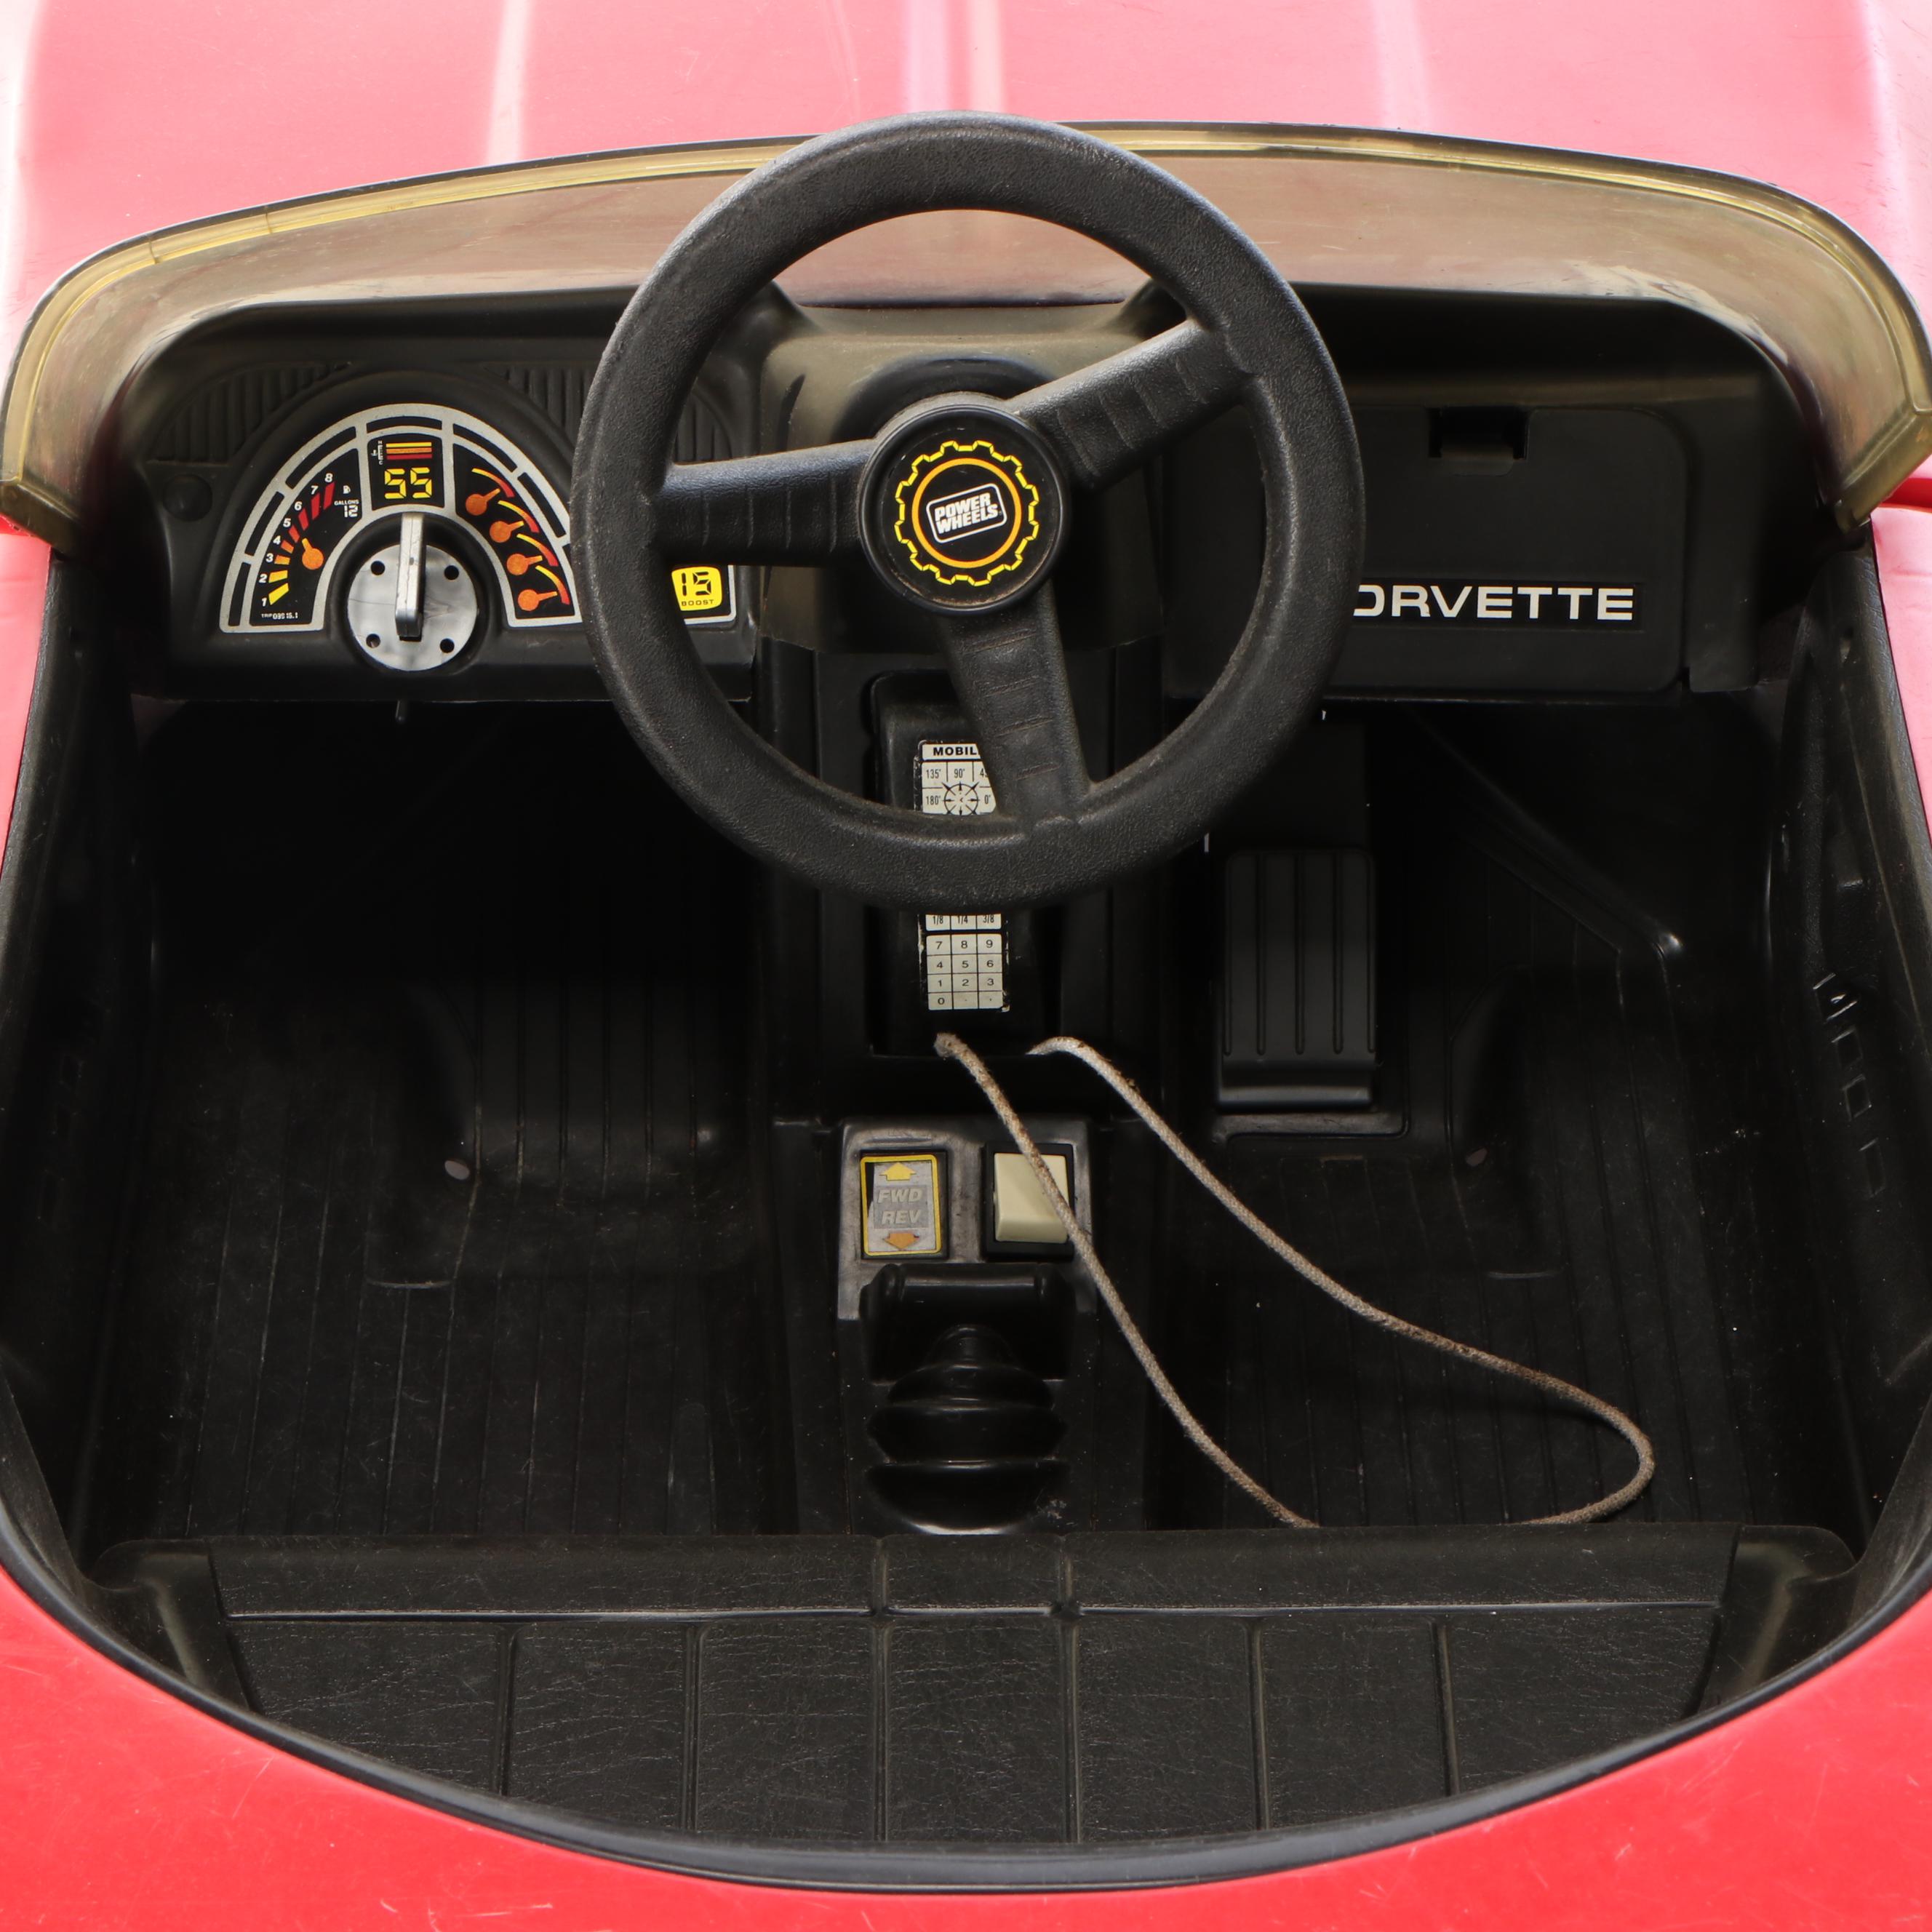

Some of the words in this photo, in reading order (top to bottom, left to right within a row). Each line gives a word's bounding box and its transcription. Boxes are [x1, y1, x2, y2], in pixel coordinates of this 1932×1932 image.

[324, 473, 333, 483] 8
[384, 467, 433, 500] 55
[311, 485, 319, 495] 7
[294, 501, 303, 511] 6
[935, 492, 991, 522] POWER
[343, 505, 359, 518] 12
[282, 518, 291, 527] 5
[935, 503, 999, 535] WHEELS
[273, 535, 282, 546] 4
[266, 553, 274, 563] 3
[258, 573, 268, 583] 2
[681, 571, 712, 596] 15
[262, 597, 267, 607] 1
[933, 746, 977, 756] MOBIL
[933, 916, 943, 925] 1/8
[983, 915, 994, 924] 3/8
[935, 941, 943, 950] 7
[960, 940, 968, 949] 8
[986, 939, 993, 949] 9
[962, 960, 969, 968] 5
[986, 959, 994, 967] 6
[962, 978, 969, 986] 2
[987, 978, 994, 986] 3
[937, 997, 945, 1005] 0
[877, 1188, 923, 1203] FWD
[881, 1210, 921, 1225] REV
